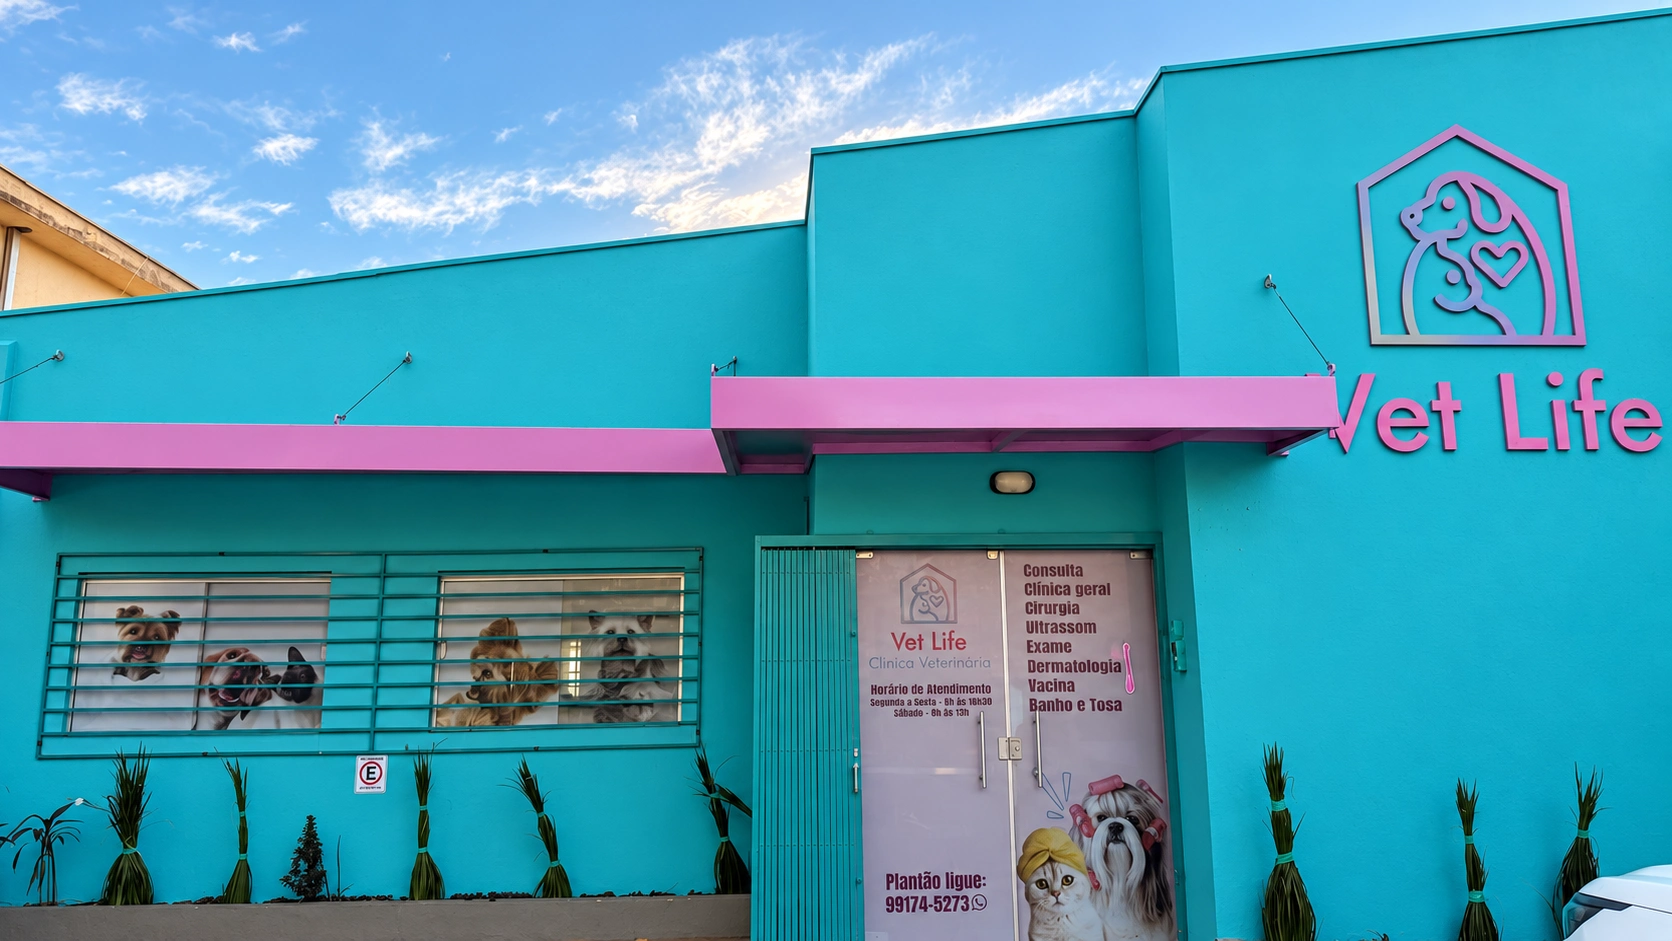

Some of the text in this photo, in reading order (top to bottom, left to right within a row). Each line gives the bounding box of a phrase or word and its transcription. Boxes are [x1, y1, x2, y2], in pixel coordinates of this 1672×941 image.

[1334, 368, 1663, 454] Vet Life
[1023, 563, 1083, 577] Consulta
[1024, 581, 1111, 597] Clínica geral
[1025, 601, 1080, 616] Cirurgia
[1026, 620, 1097, 634] Ultrassom
[890, 630, 967, 651] Vet Life
[1026, 640, 1072, 653] Exame
[919, 656, 991, 669] Veterinária
[1028, 659, 1122, 674] Dermatologia
[870, 683, 992, 695] Horário de Atendimento
[1028, 678, 1075, 692] Vacina
[870, 698, 905, 707] Segunda
[914, 698, 936, 706] Sexta
[1029, 698, 1122, 712] Banho e Tosa
[893, 708, 924, 717] Sábado
[955, 708, 969, 716] 13h
[366, 766, 376, 780] E
[885, 871, 987, 892] Plantão ligue:
[885, 895, 970, 913] 99174-5273
